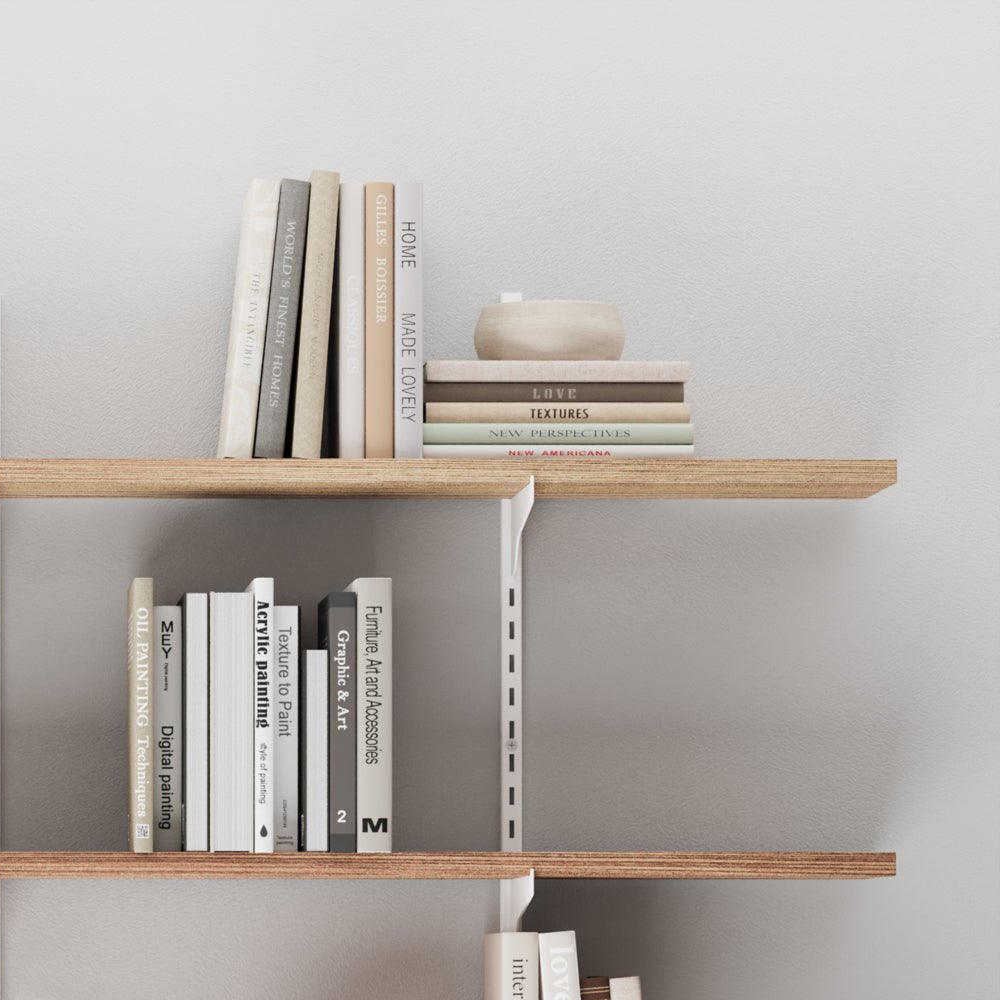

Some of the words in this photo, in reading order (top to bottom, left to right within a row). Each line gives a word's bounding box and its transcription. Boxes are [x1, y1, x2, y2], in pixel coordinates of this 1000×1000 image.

[376, 194, 387, 245] GILLES
[282, 220, 297, 288] WORLD'S
[401, 221, 416, 268] HOME
[252, 273, 261, 297] THE
[376, 258, 387, 324] BOISSIER
[276, 294, 289, 348] FINEST
[344, 274, 360, 375] CLASSIQUES
[401, 313, 416, 358] MADE
[269, 352, 283, 408] HOMES
[401, 367, 416, 423] LOVELY
[532, 387, 578, 400] LOVE
[489, 429, 521, 438] NEW
[530, 429, 630, 438] PERSPECTIVES
[530, 408, 589, 420] TEXTURES
[136, 607, 148, 636] OIL
[257, 601, 269, 654] Acrylic
[366, 606, 382, 656] Furniture,
[279, 627, 292, 678] Texture
[336, 630, 350, 686] Graphic
[366, 658, 382, 674] Art
[136, 640, 148, 727] PAINTING
[257, 660, 269, 728] painting
[279, 681, 292, 695] to
[337, 690, 350, 702] &
[366, 676, 382, 697] and
[279, 701, 292, 737] Paint
[338, 706, 349, 730] Art
[366, 700, 382, 765] Accessories
[159, 726, 174, 770] Digital
[260, 763, 267, 771] of
[136, 736, 149, 817] Techniques
[159, 775, 174, 830] painting
[337, 810, 346, 823] 2
[362, 818, 388, 832] M
